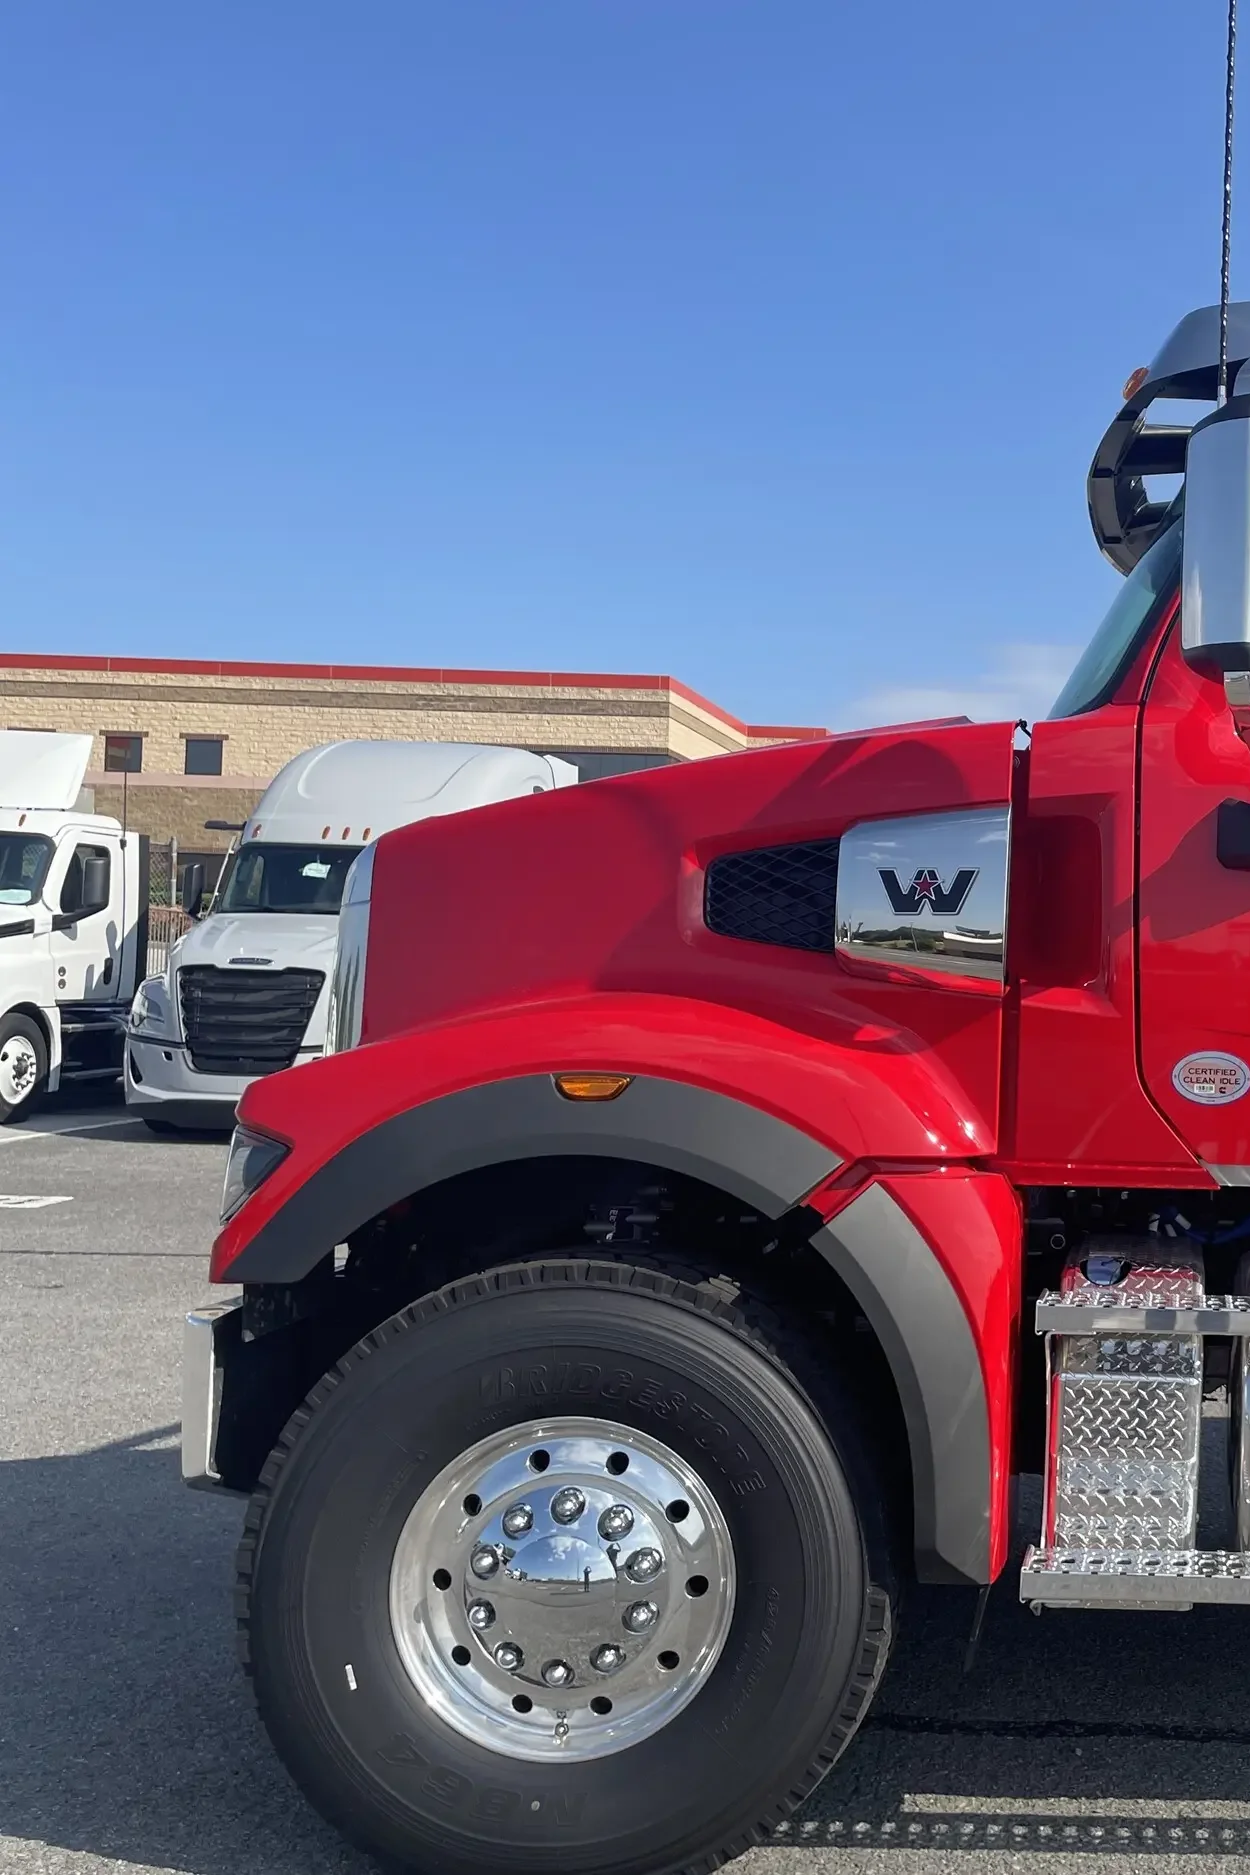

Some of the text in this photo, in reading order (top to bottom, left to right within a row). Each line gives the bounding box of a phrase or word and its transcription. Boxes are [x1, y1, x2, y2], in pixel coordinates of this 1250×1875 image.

[1188, 1067, 1237, 1076] CERTIFIED
[1183, 1076, 1241, 1085] CLEAN IDLE
